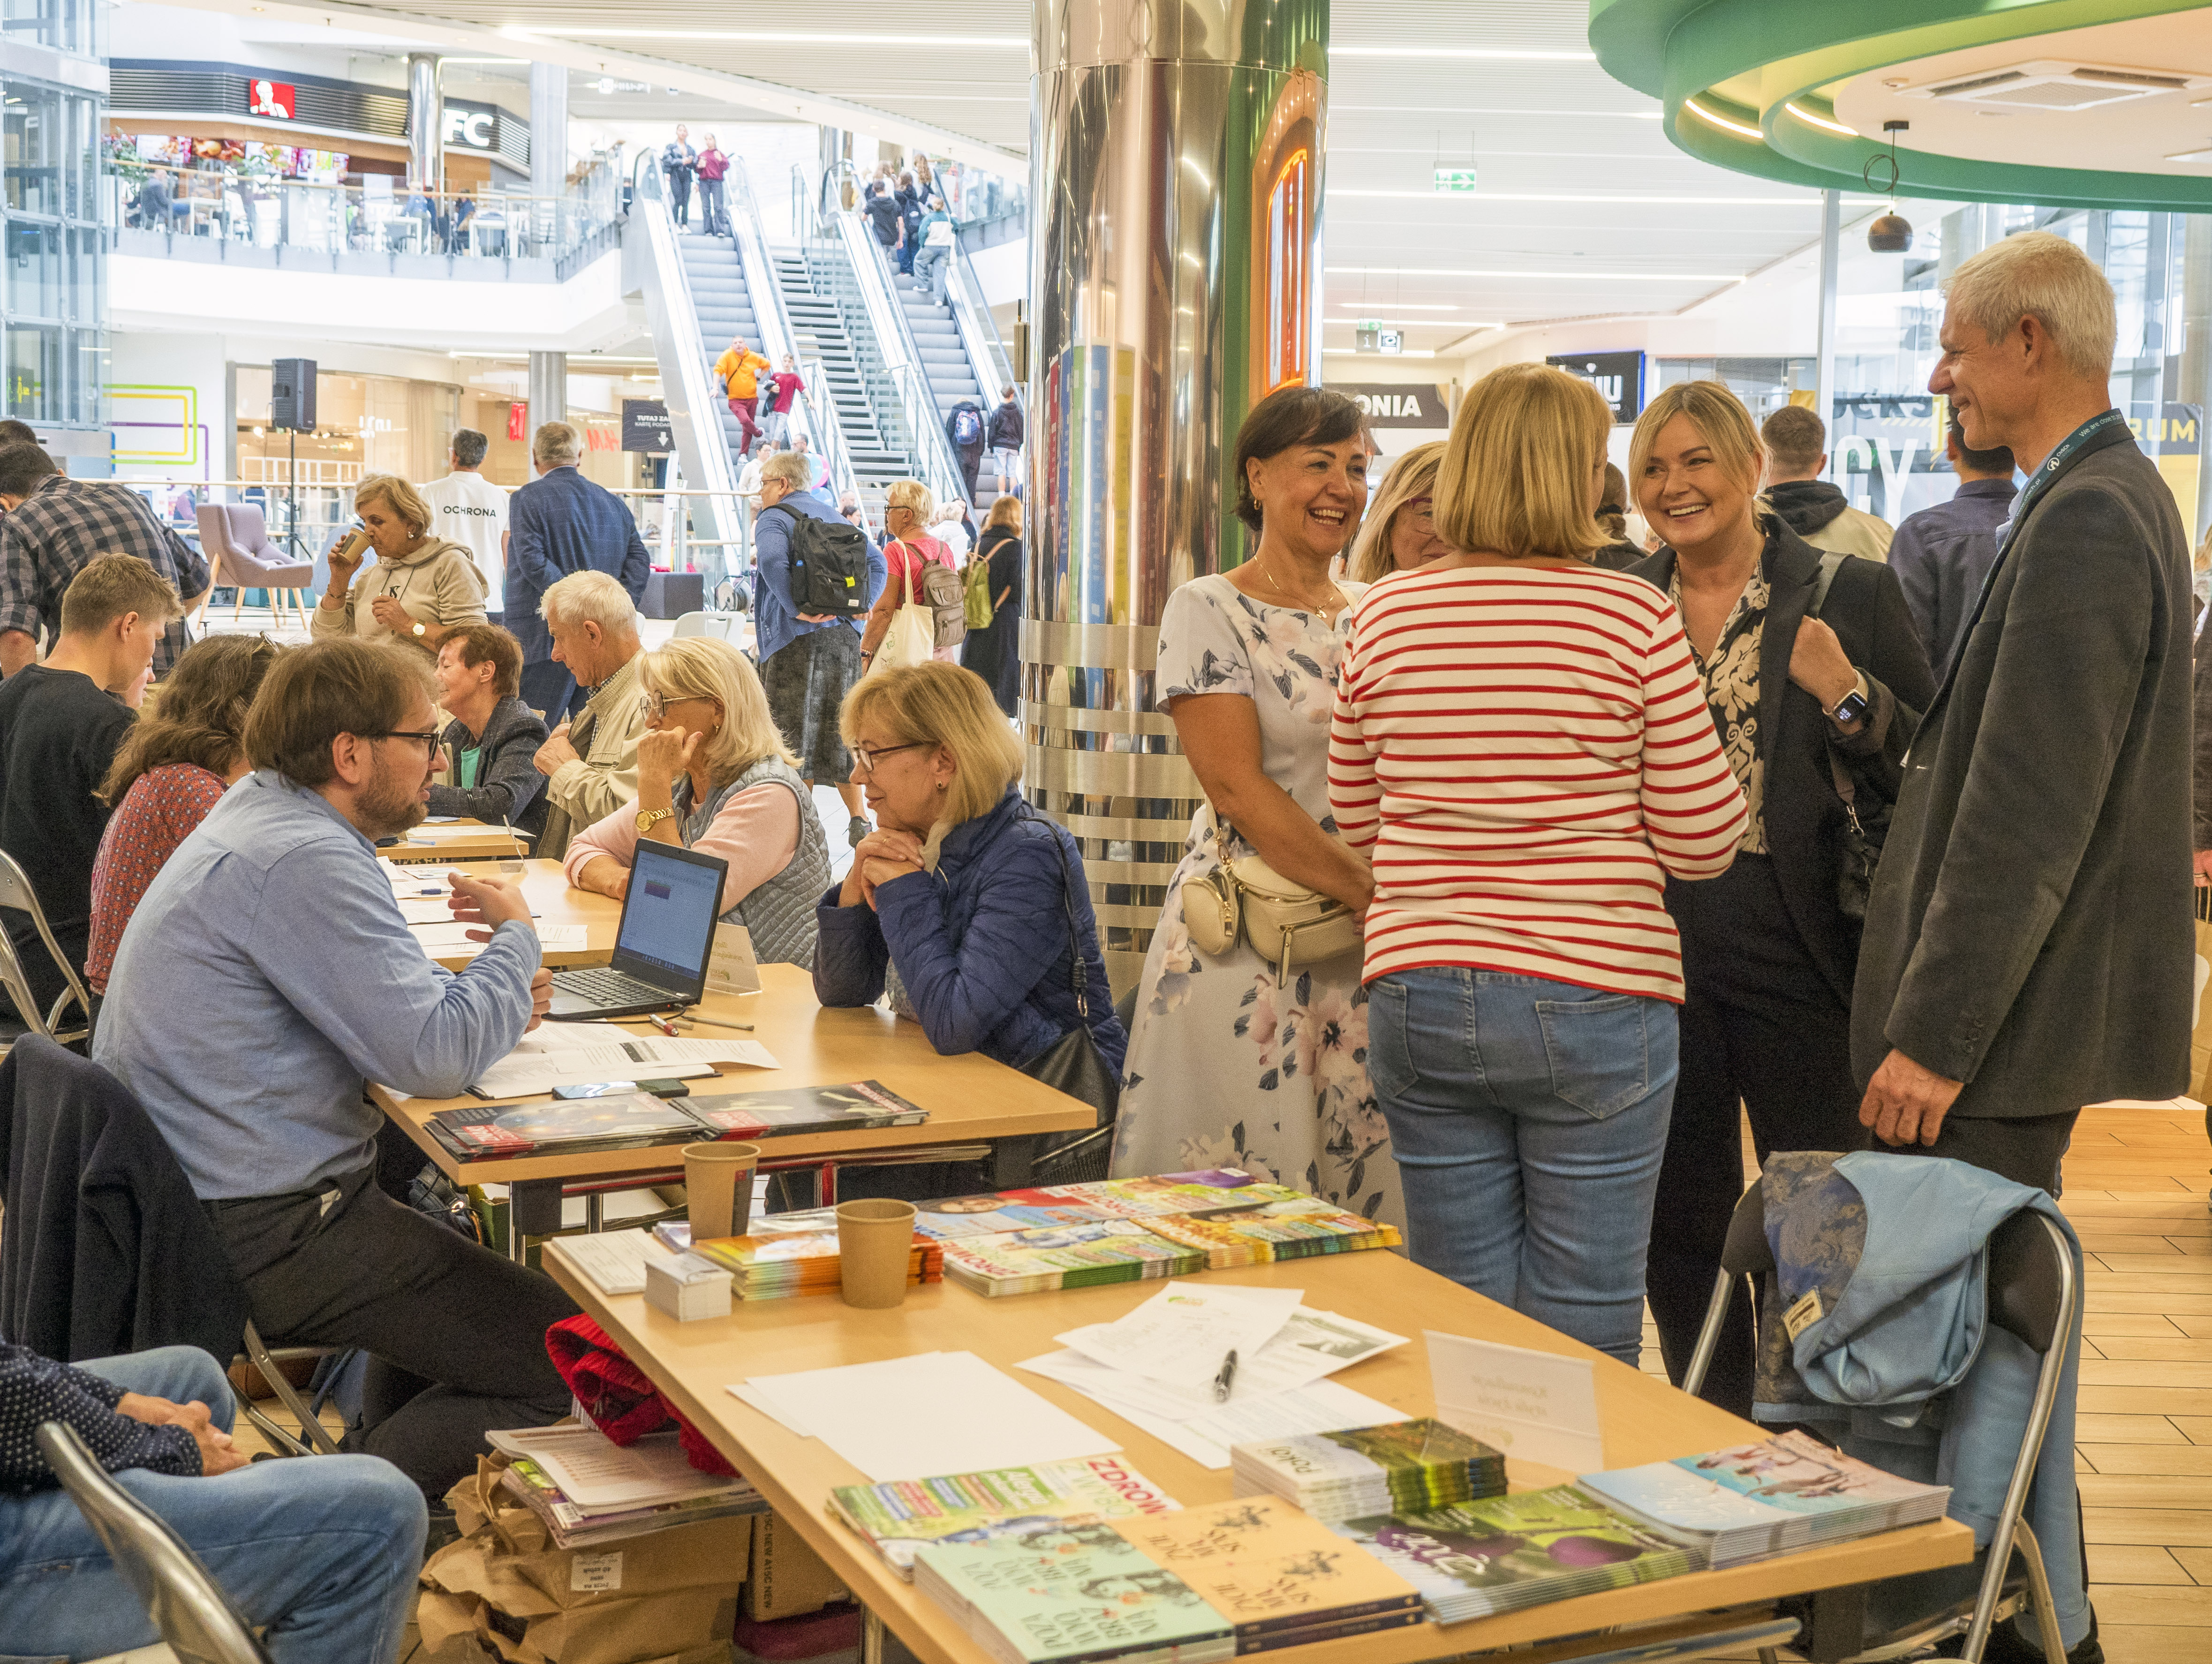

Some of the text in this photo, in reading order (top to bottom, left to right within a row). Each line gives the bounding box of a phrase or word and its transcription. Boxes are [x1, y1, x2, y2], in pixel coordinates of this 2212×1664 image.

[2079, 427, 2090, 437] We
[443, 506, 496, 517] OCHRONA
[764, 1533, 773, 1557] NEW
[764, 1586, 773, 1609] NEW
